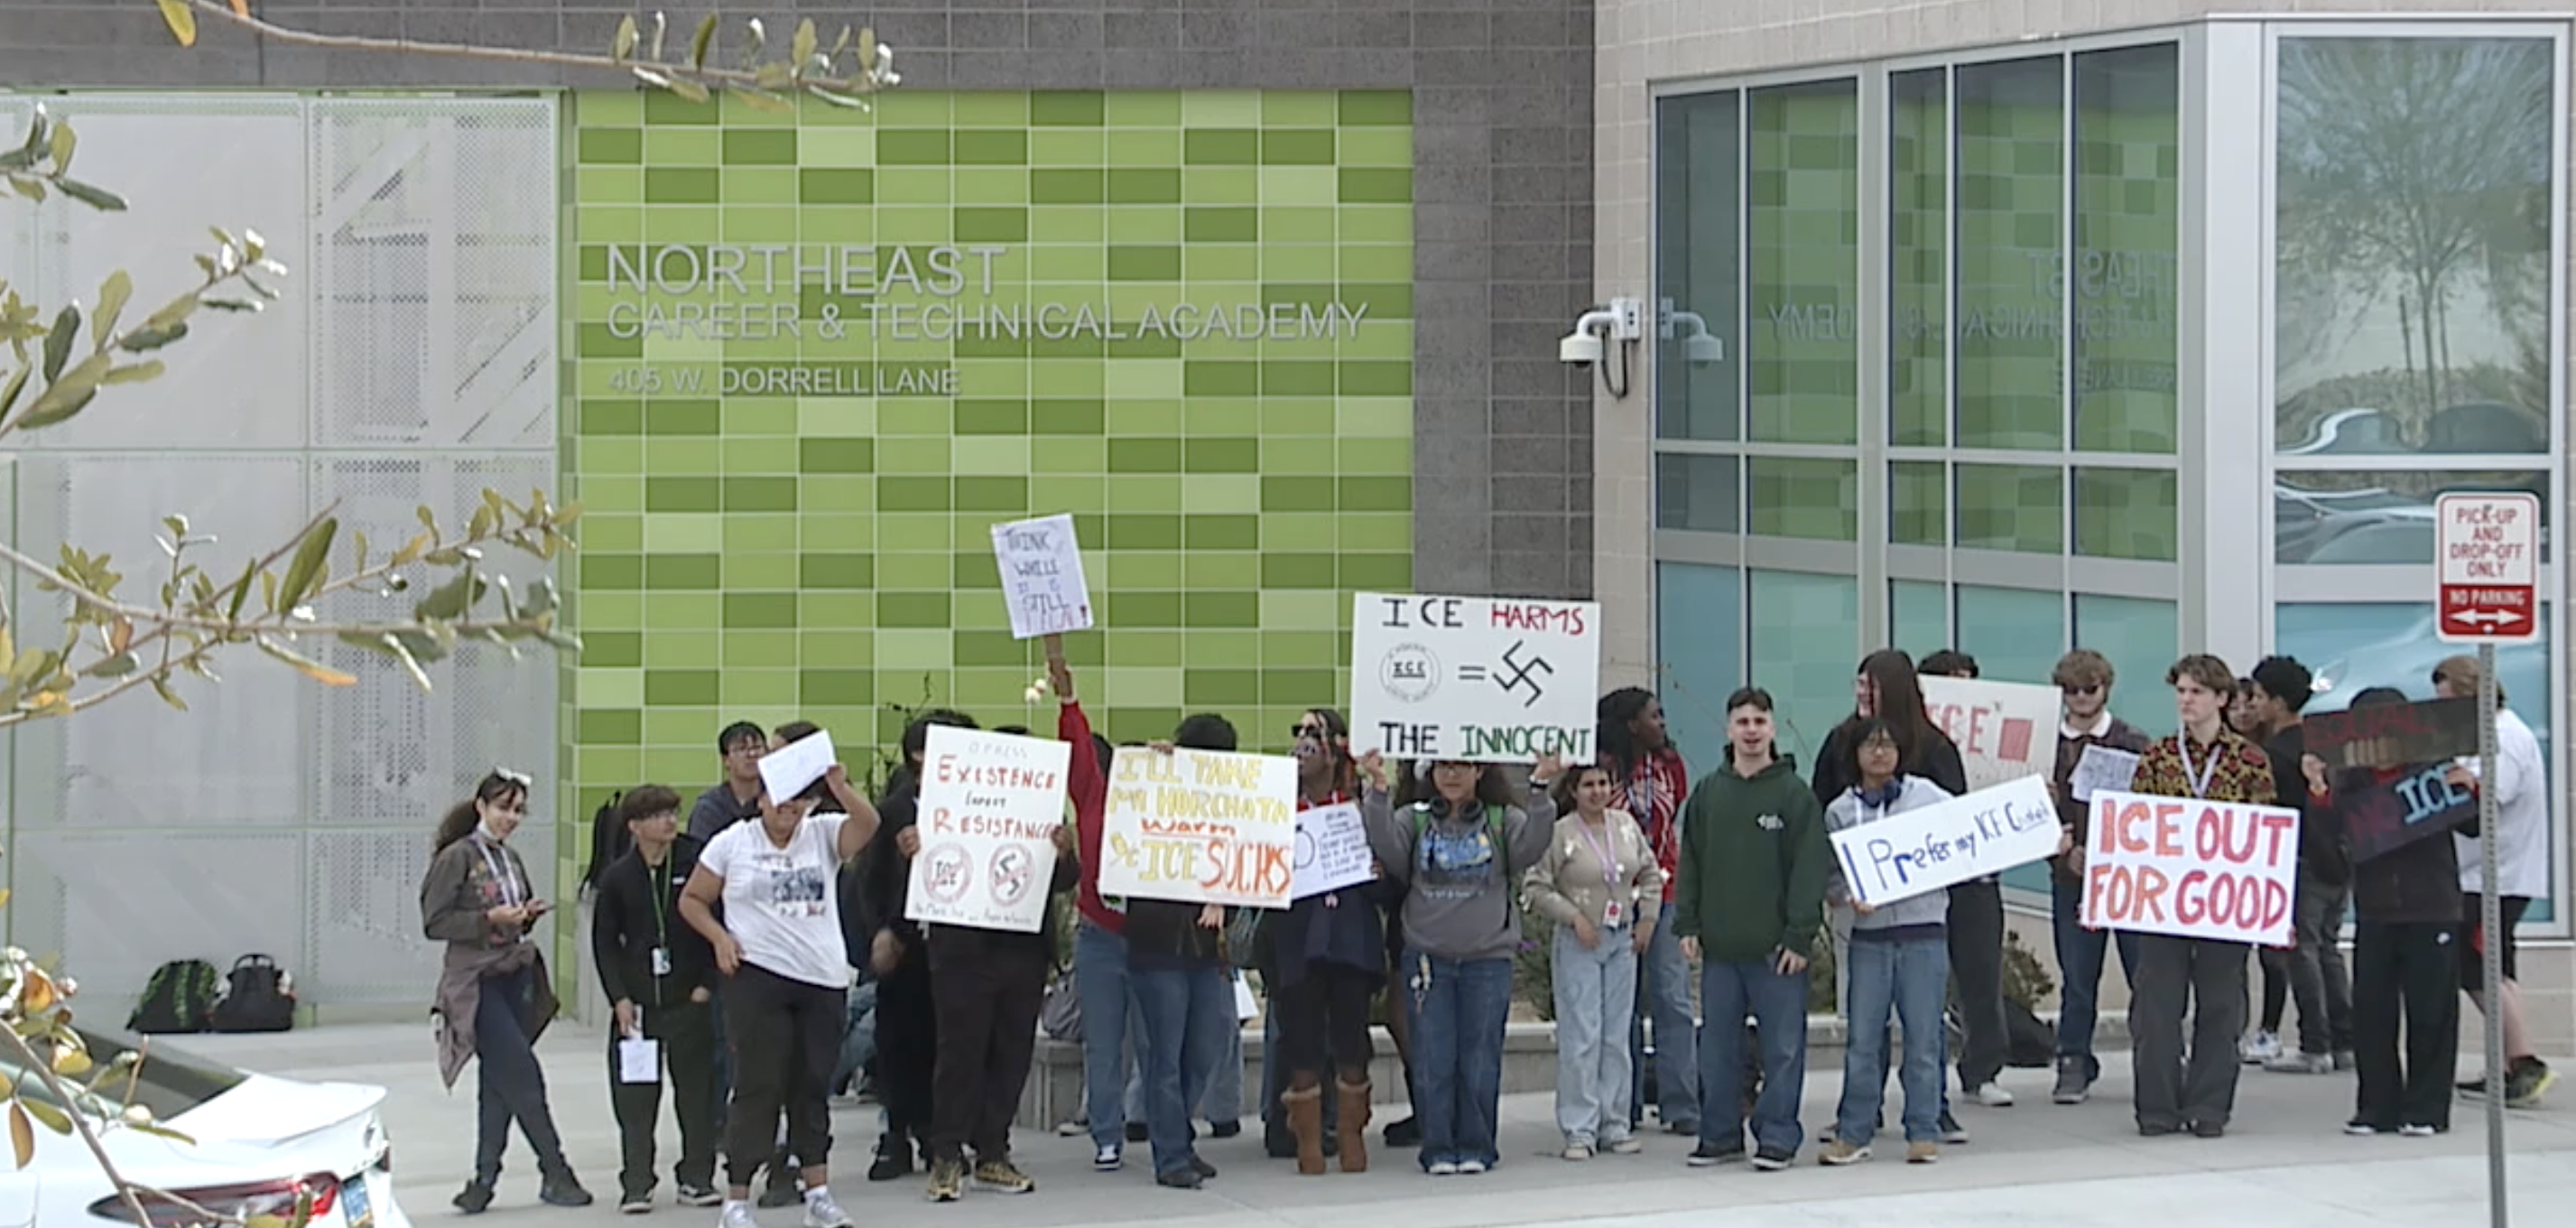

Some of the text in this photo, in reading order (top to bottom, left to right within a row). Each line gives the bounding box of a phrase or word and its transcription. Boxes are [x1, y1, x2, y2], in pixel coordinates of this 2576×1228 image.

[607, 244, 1006, 295] NORTHEAST
[607, 301, 1368, 340] CAREER & TECHNICAL ACADEMY
[608, 368, 960, 395] 405 W. DORRELL LANE
[2456, 507, 2517, 524] PICK-UP
[2472, 526, 2503, 541] AND
[2450, 544, 2524, 560] DROP-OFF
[2467, 562, 2506, 577] ONLY
[1382, 598, 1585, 635] ICE HARMS
[2449, 590, 2525, 606] NO PARKING
[1392, 661, 1425, 674] ICE
[1378, 721, 1591, 758] THE INNOCENT
[1116, 752, 1262, 790] I'LL TAKE
[1156, 786, 1289, 825] HORCHATA
[2395, 762, 2471, 825] ICE
[2099, 798, 2294, 867] ICE OUT
[1138, 839, 1202, 881] ICE
[1200, 838, 1291, 896] SUCKS
[1841, 842, 1867, 902] I
[1955, 832, 1977, 858] my
[2088, 862, 2288, 932] FOR GOOD
